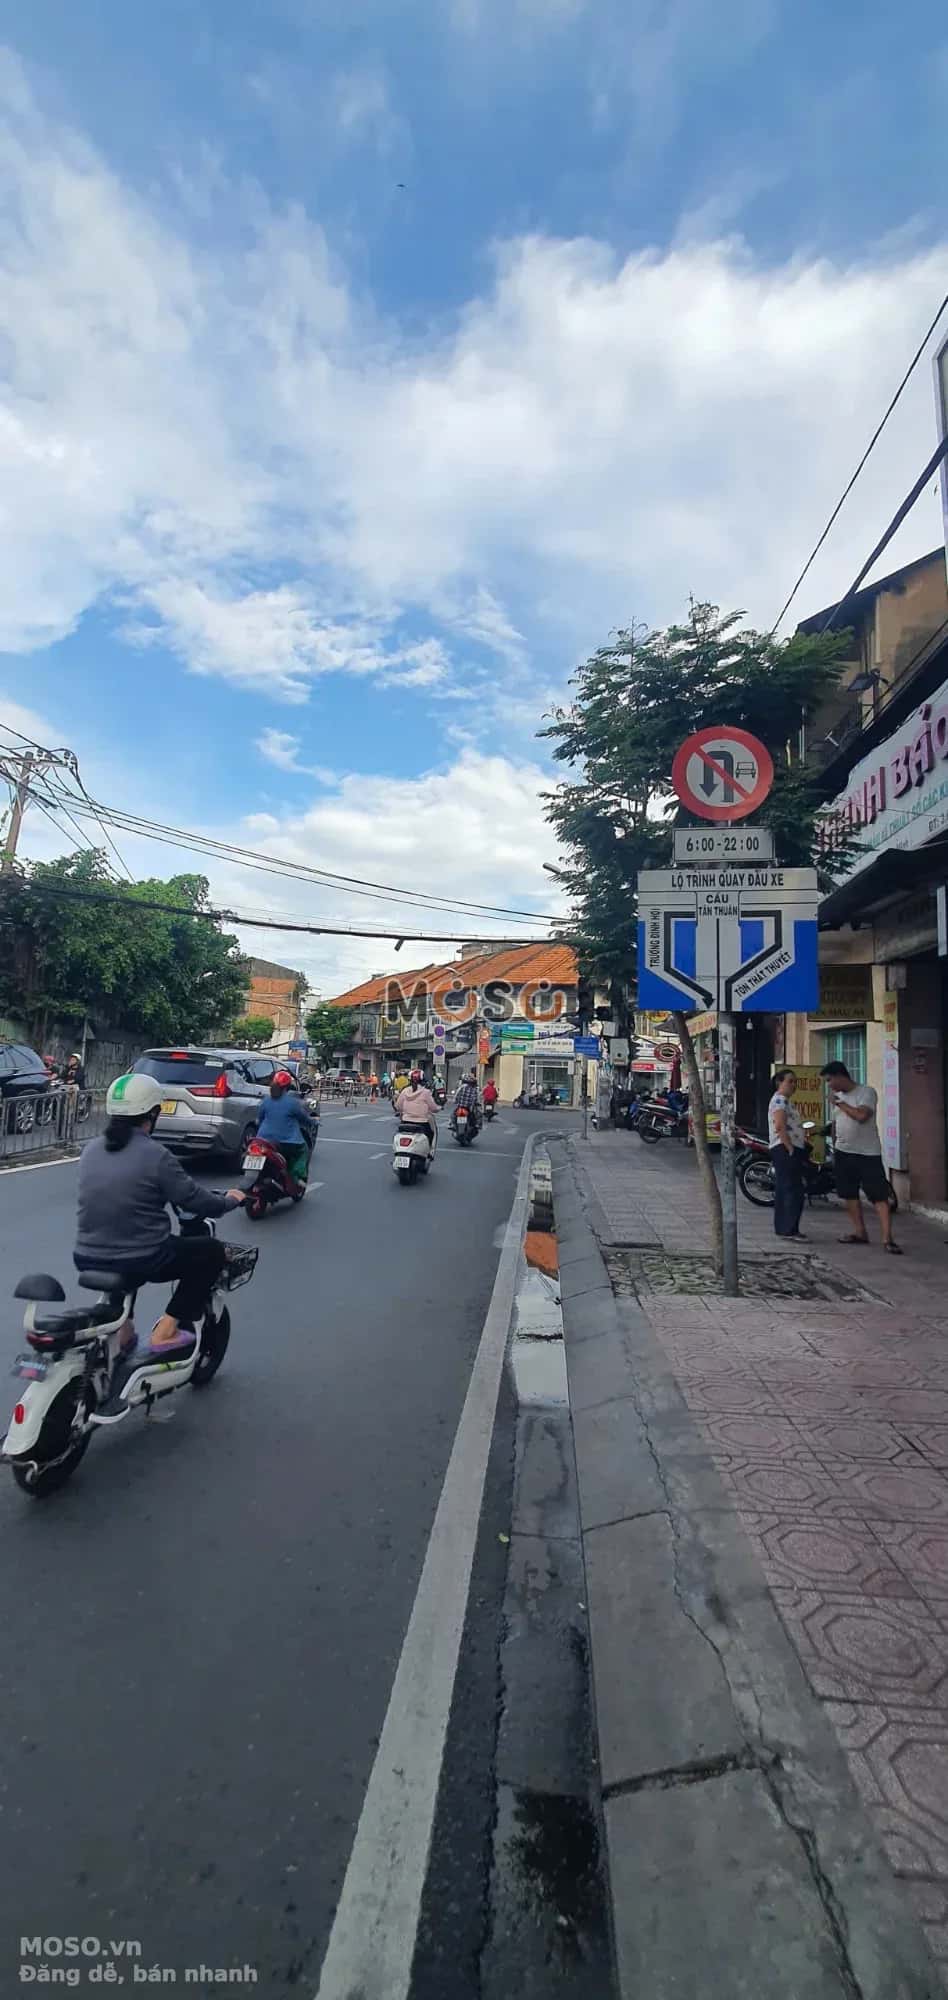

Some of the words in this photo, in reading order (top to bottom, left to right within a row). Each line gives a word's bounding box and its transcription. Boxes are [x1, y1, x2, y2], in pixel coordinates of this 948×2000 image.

[686, 871, 716, 889] TRÌNH
[718, 873, 745, 888] QUAY
[748, 869, 768, 887] ĐẦU
[771, 873, 784, 887] XE
